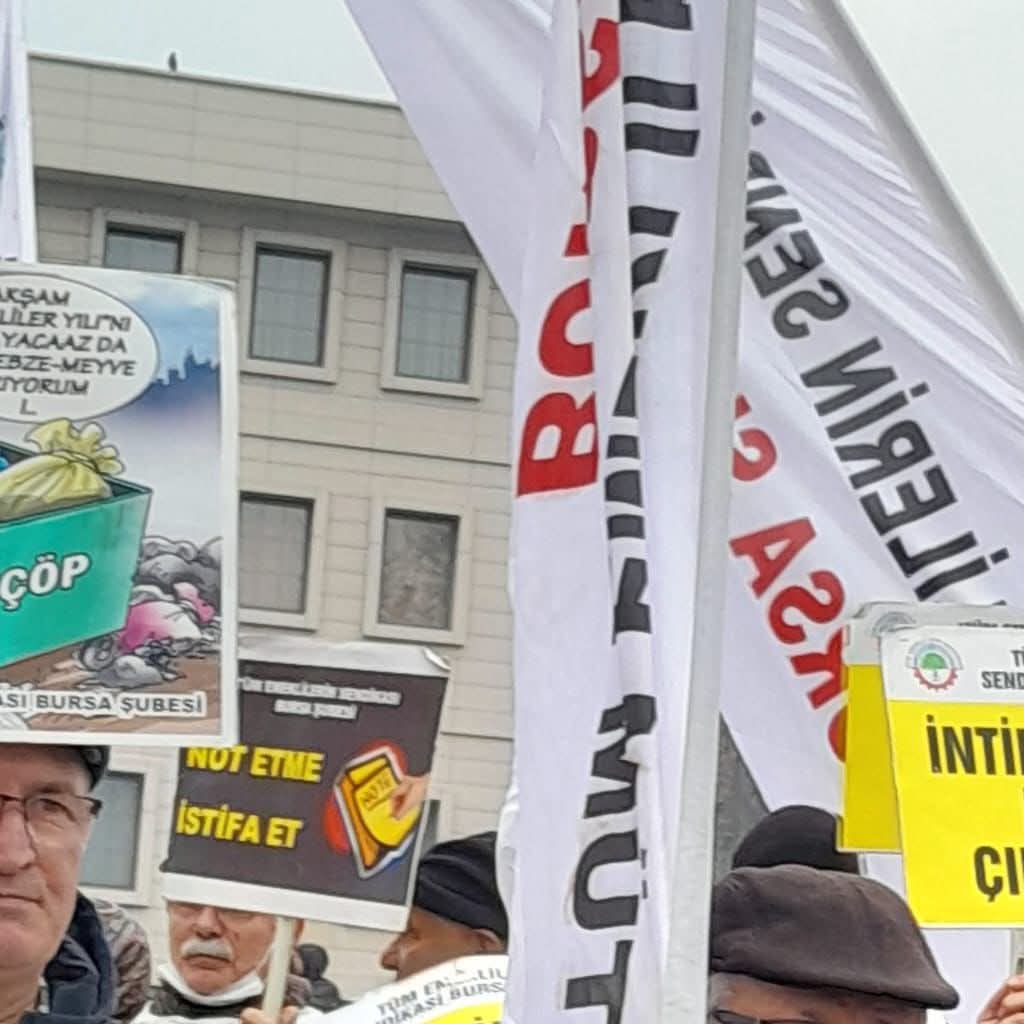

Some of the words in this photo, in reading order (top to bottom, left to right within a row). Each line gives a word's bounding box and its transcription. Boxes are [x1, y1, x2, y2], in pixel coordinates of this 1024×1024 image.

[97, 336, 127, 353] DA
[0, 553, 92, 612] ÇÖP
[0, 693, 27, 709] SI
[36, 694, 112, 710] BURSA
[120, 696, 202, 713] ŞUBESİ
[250, 746, 325, 783] ETME
[175, 799, 262, 844] İSTİFA
[265, 817, 304, 848] ET
